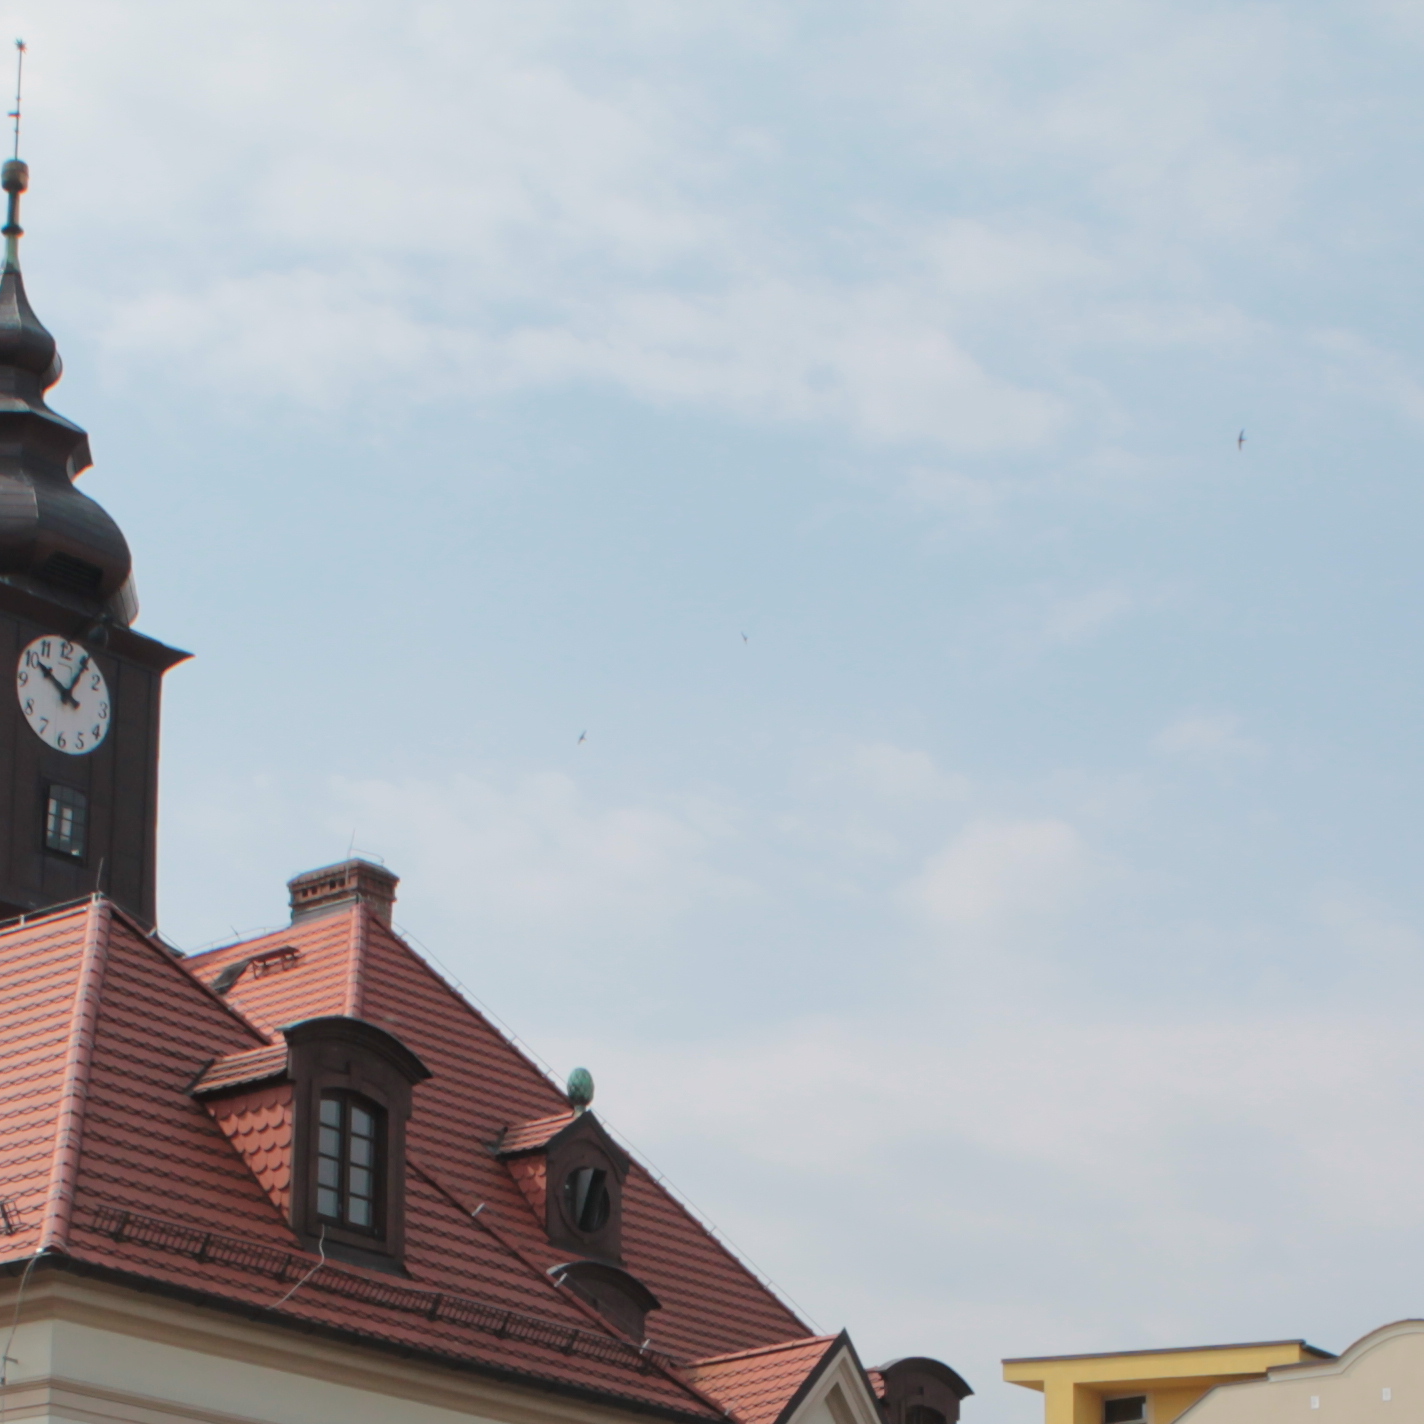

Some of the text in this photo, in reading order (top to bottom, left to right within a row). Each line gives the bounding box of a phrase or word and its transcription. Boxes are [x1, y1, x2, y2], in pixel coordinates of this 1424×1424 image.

[41, 640, 51, 658] 11
[60, 642, 74, 660] 12
[26, 650, 40, 669] 10
[18, 671, 28, 687] 9
[91, 674, 100, 691] 2
[25, 698, 34, 716] 8
[98, 701, 108, 720] 3
[40, 717, 49, 734] 7
[92, 724, 101, 741] 4
[57, 731, 66, 748] 6
[75, 732, 84, 750] 5
